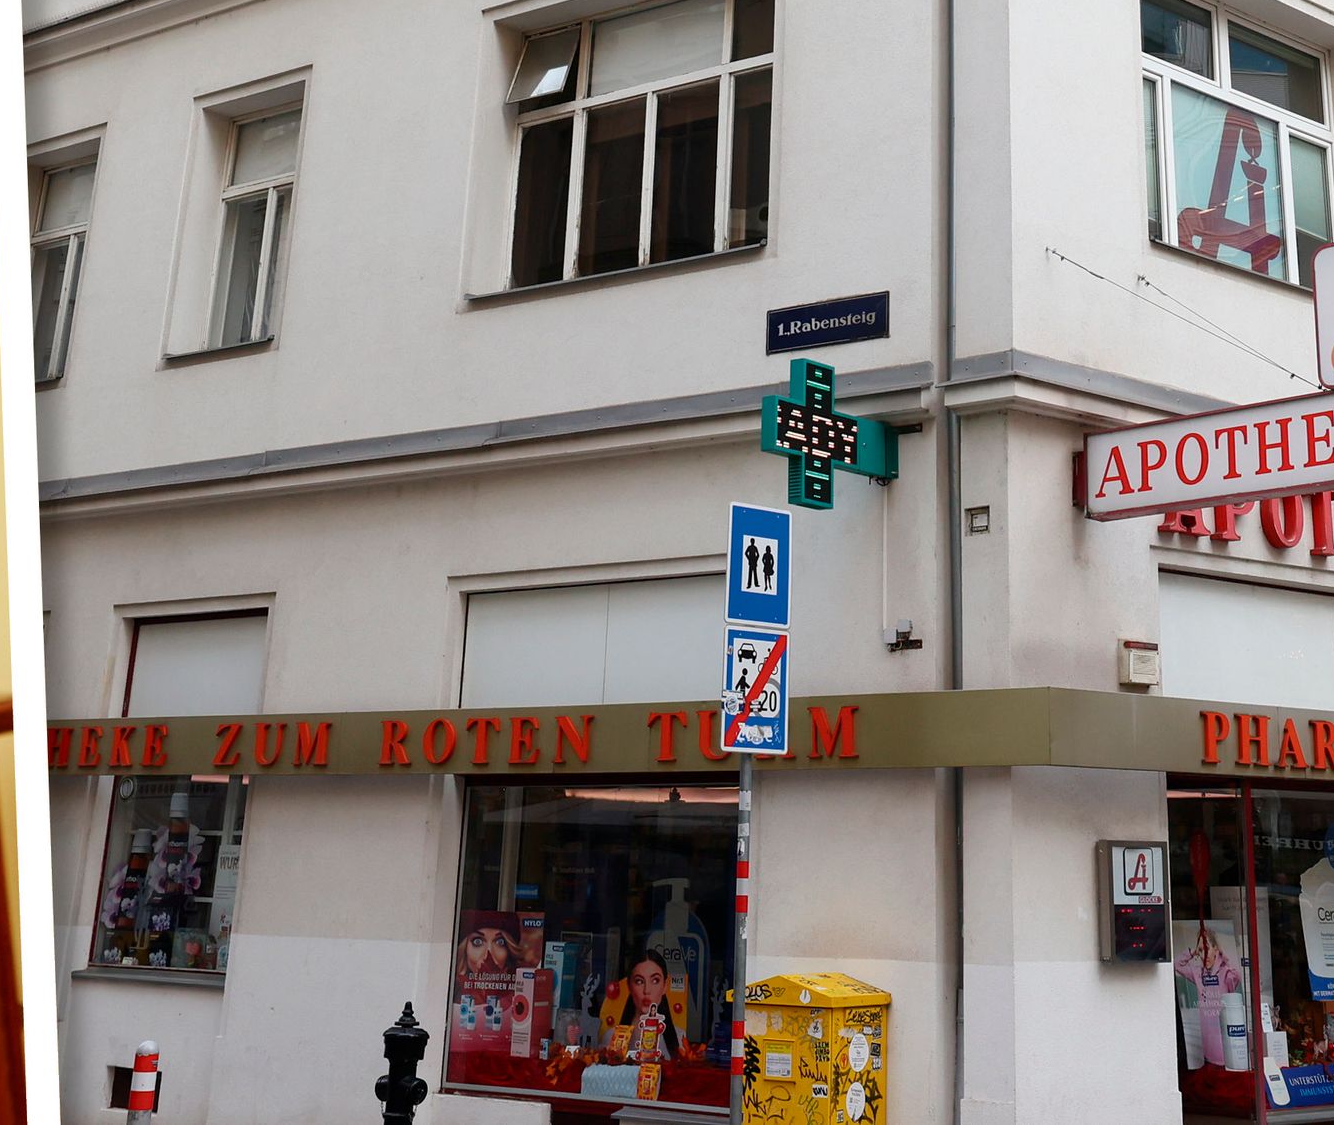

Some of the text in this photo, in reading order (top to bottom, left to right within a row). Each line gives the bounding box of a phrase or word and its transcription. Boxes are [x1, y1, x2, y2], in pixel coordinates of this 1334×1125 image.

[211, 722, 332, 767] ZUM
[379, 714, 595, 767] ROTEN
[647, 706, 860, 762] TUM
[1289, 1073, 1332, 1087] UNTERSTÜTZ
